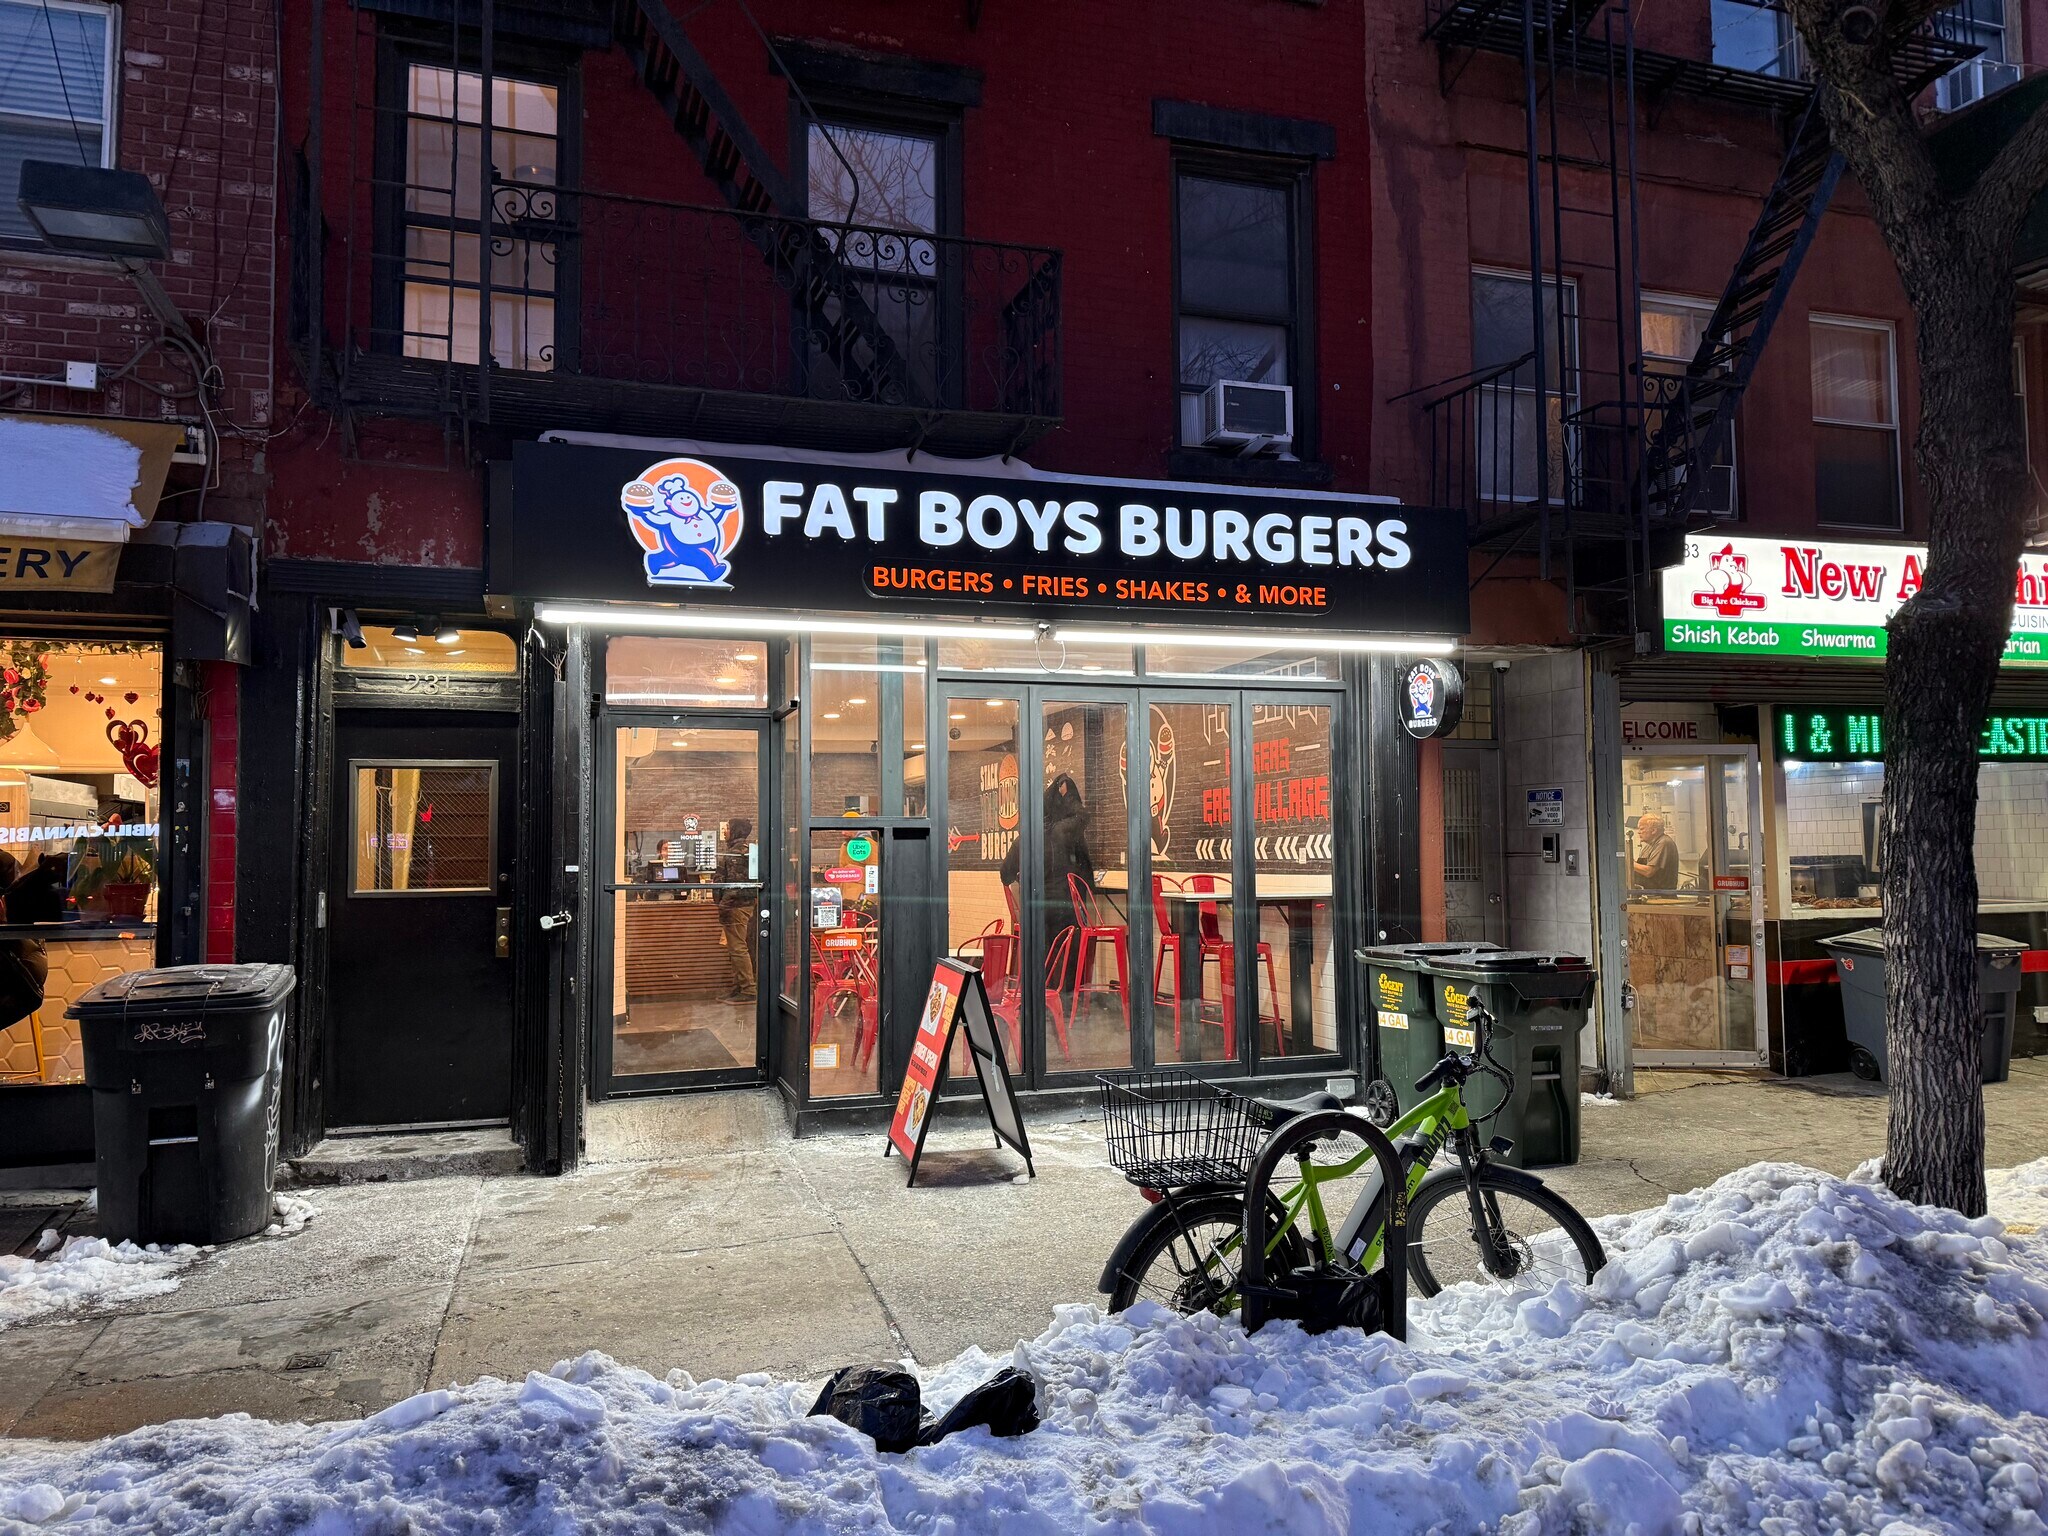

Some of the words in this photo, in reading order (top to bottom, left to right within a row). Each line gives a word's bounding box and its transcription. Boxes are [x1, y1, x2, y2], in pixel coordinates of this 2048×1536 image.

[763, 480, 898, 541] FAT
[919, 490, 1102, 555] BOYS
[1119, 504, 1412, 569] BURGERS
[1780, 546, 1884, 600] New
[873, 566, 994, 593] BURGERS
[1022, 575, 1089, 598] FRIES
[1116, 578, 1210, 602] SHAKES
[1235, 584, 1252, 603] &
[1259, 585, 1327, 607] MORE
[1730, 597, 1758, 607] Chicken
[2012, 614, 2048, 629] UISIN
[1671, 624, 1721, 644] Shish
[1727, 626, 1780, 646] Kebab
[1801, 628, 1876, 649] Shwarma
[1408, 666, 1418, 683] FAT
[1420, 664, 1436, 680] BOYS
[405, 673, 453, 695] 231
[1408, 718, 1437, 729] BURGERS
[1621, 721, 1698, 740] ELCOME
[1809, 714, 1832, 754] &
[1536, 791, 1555, 801] NOTICE
[1203, 785, 1230, 828] EAS
[825, 938, 858, 947] GRUBHUB
[1388, 1013, 1408, 1028] GAL
